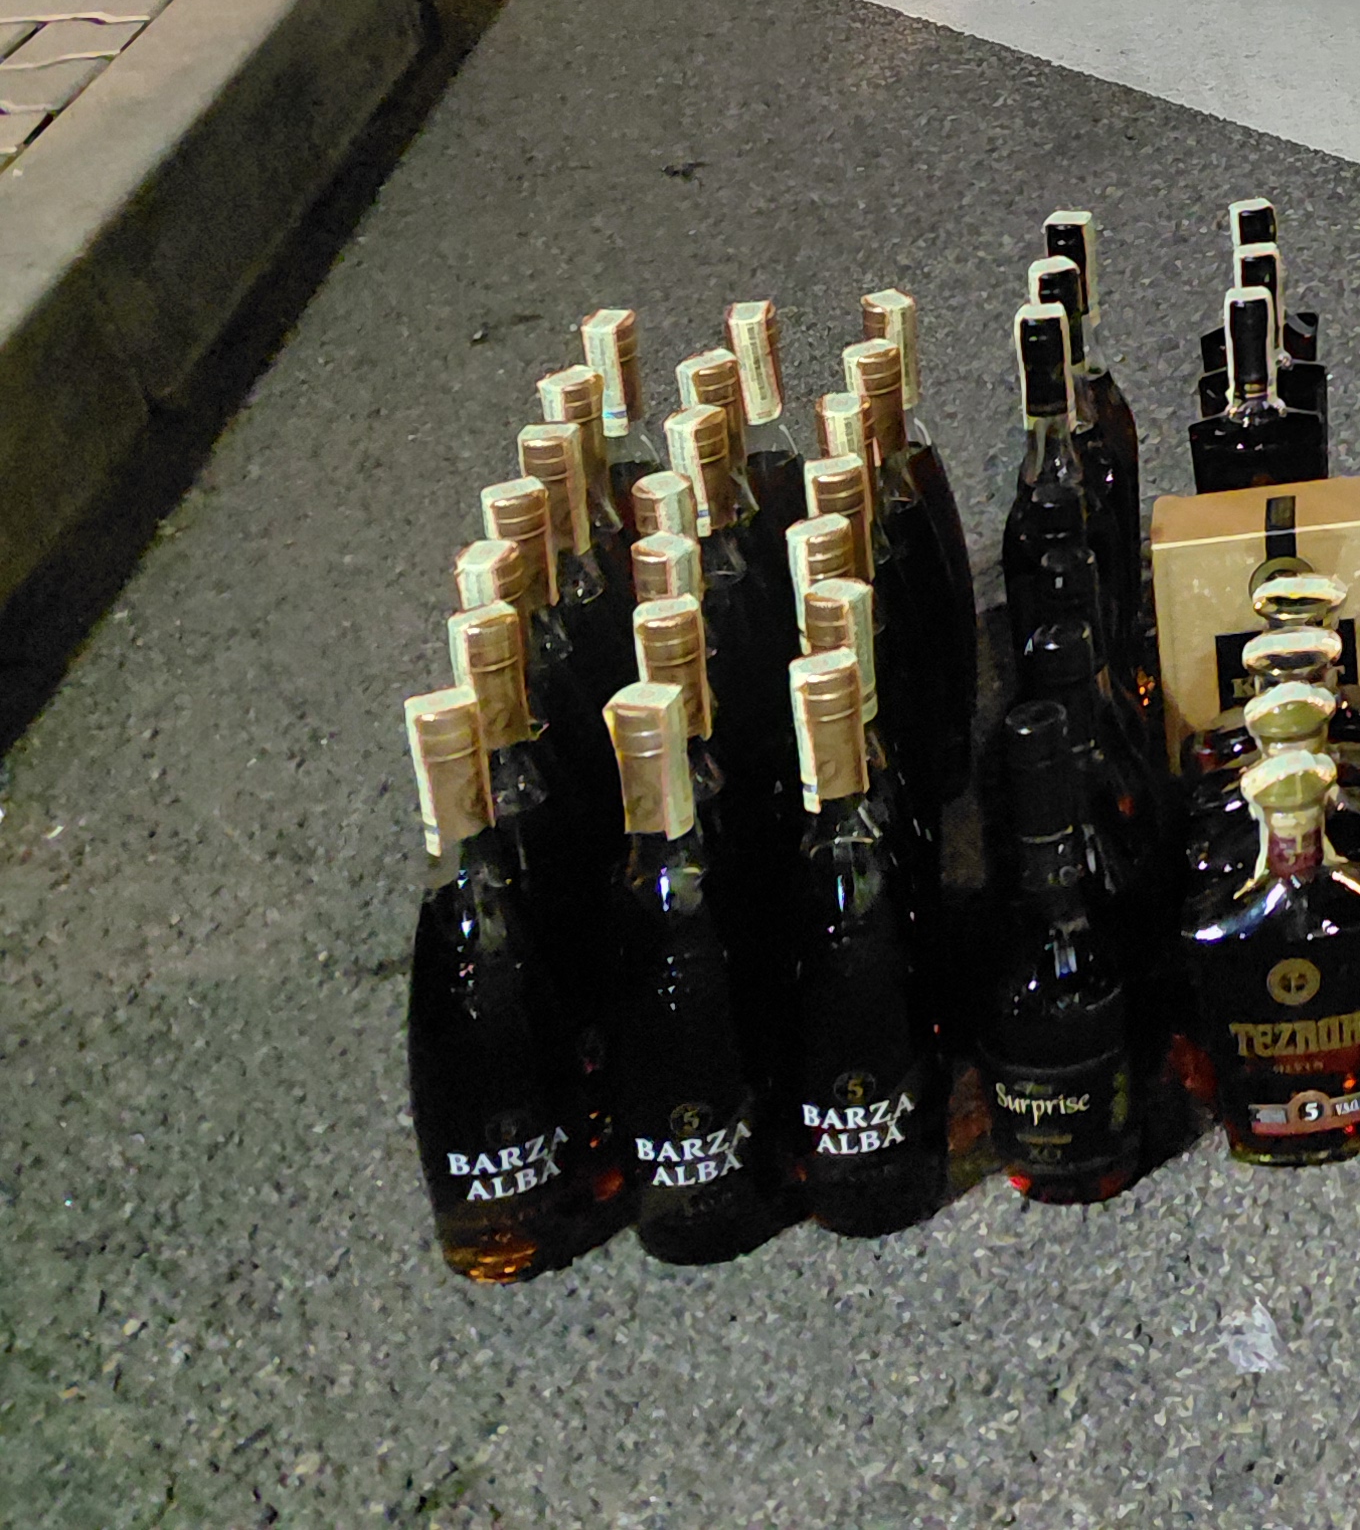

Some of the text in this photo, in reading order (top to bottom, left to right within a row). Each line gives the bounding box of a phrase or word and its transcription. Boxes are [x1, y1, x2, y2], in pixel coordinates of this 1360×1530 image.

[801, 1091, 916, 1131] BARZA
[995, 1082, 1090, 1127] Surprise
[1304, 1102, 1319, 1122] 5
[446, 1125, 570, 1176] BARZA
[634, 1119, 753, 1163] BARZA
[816, 1118, 906, 1155] ALBA
[465, 1153, 562, 1202] ALBA
[651, 1147, 744, 1187] ALBA
